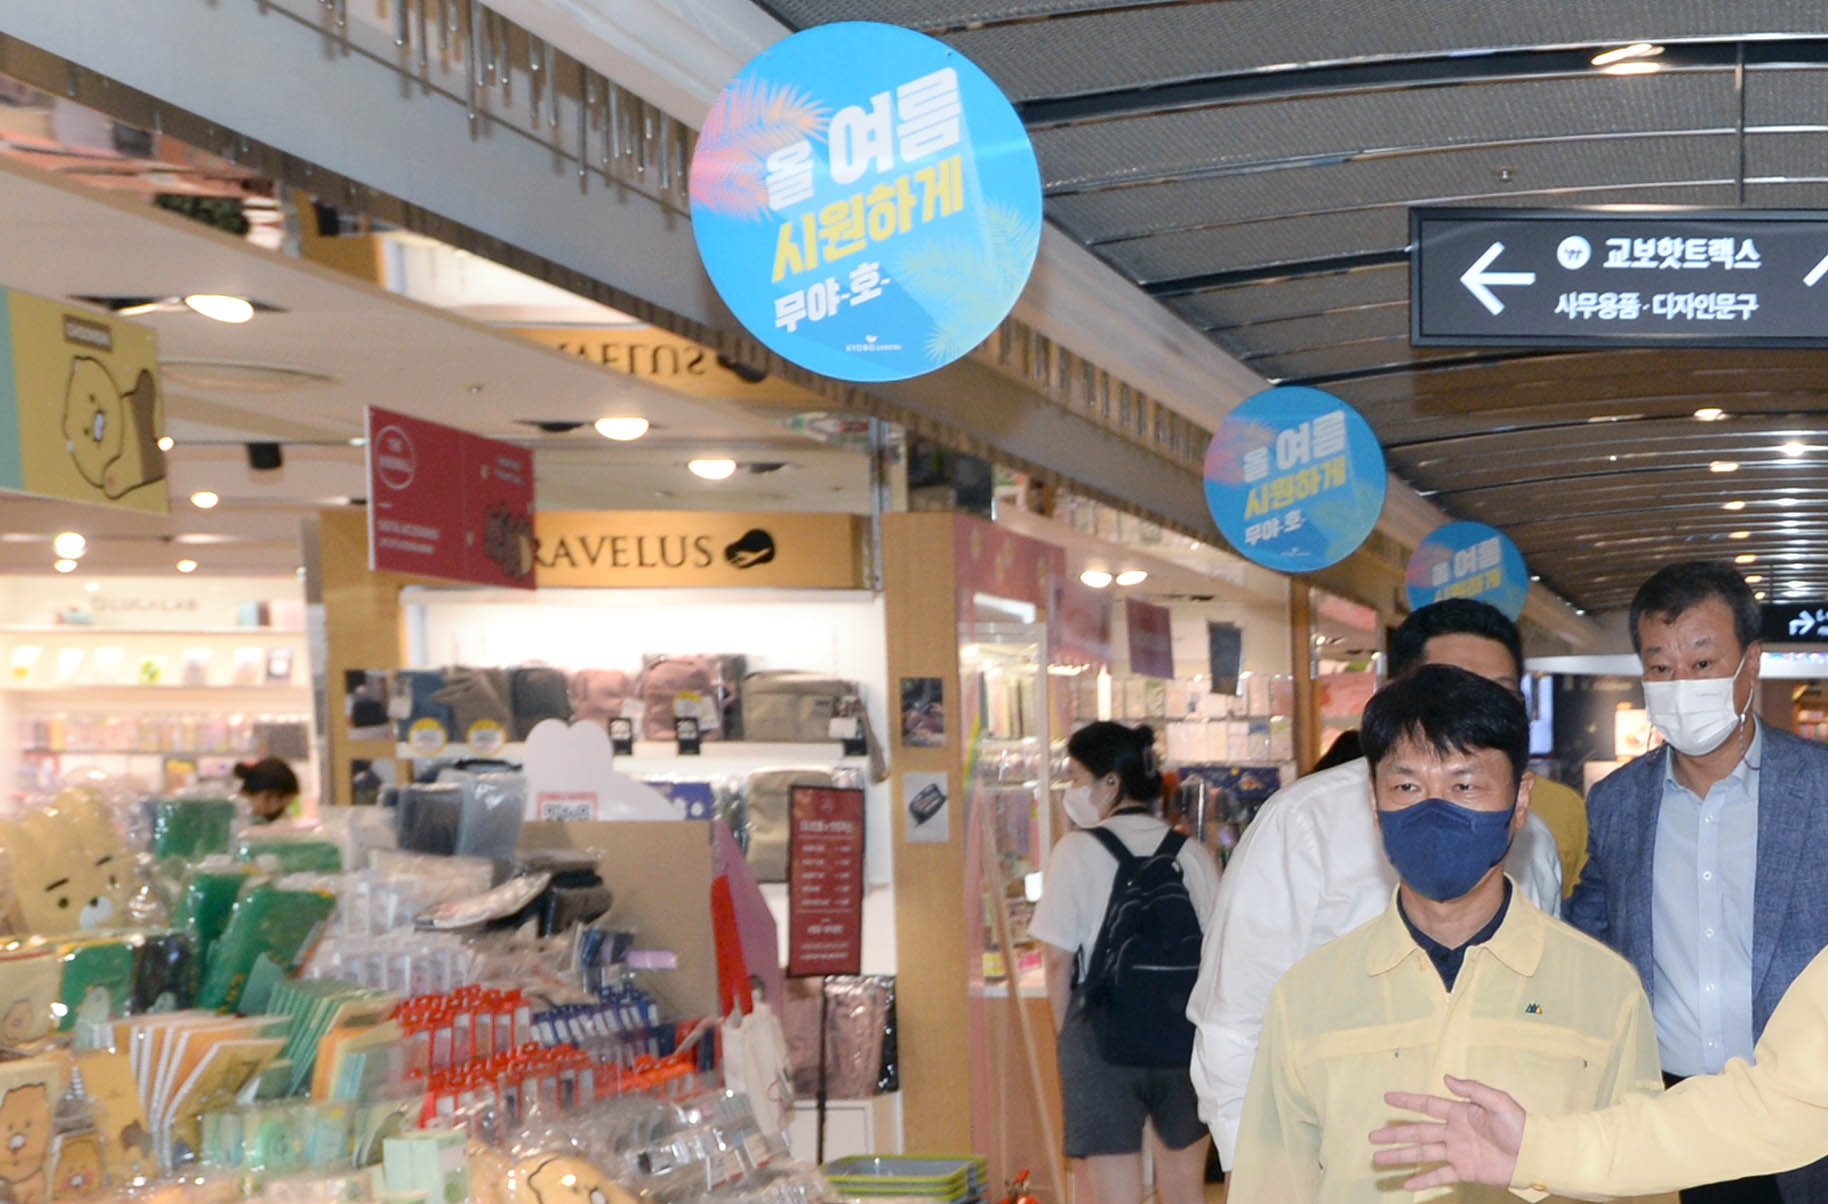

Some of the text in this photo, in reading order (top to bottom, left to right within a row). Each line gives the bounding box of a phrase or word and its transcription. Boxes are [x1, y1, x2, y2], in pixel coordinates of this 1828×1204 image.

[766, 67, 961, 211] 올 여름
[771, 155, 964, 284] 시원하게
[1603, 237, 1762, 270] 교보핫트랙스
[1276, 410, 1346, 470] 여름
[1244, 455, 1347, 520] 시원하게
